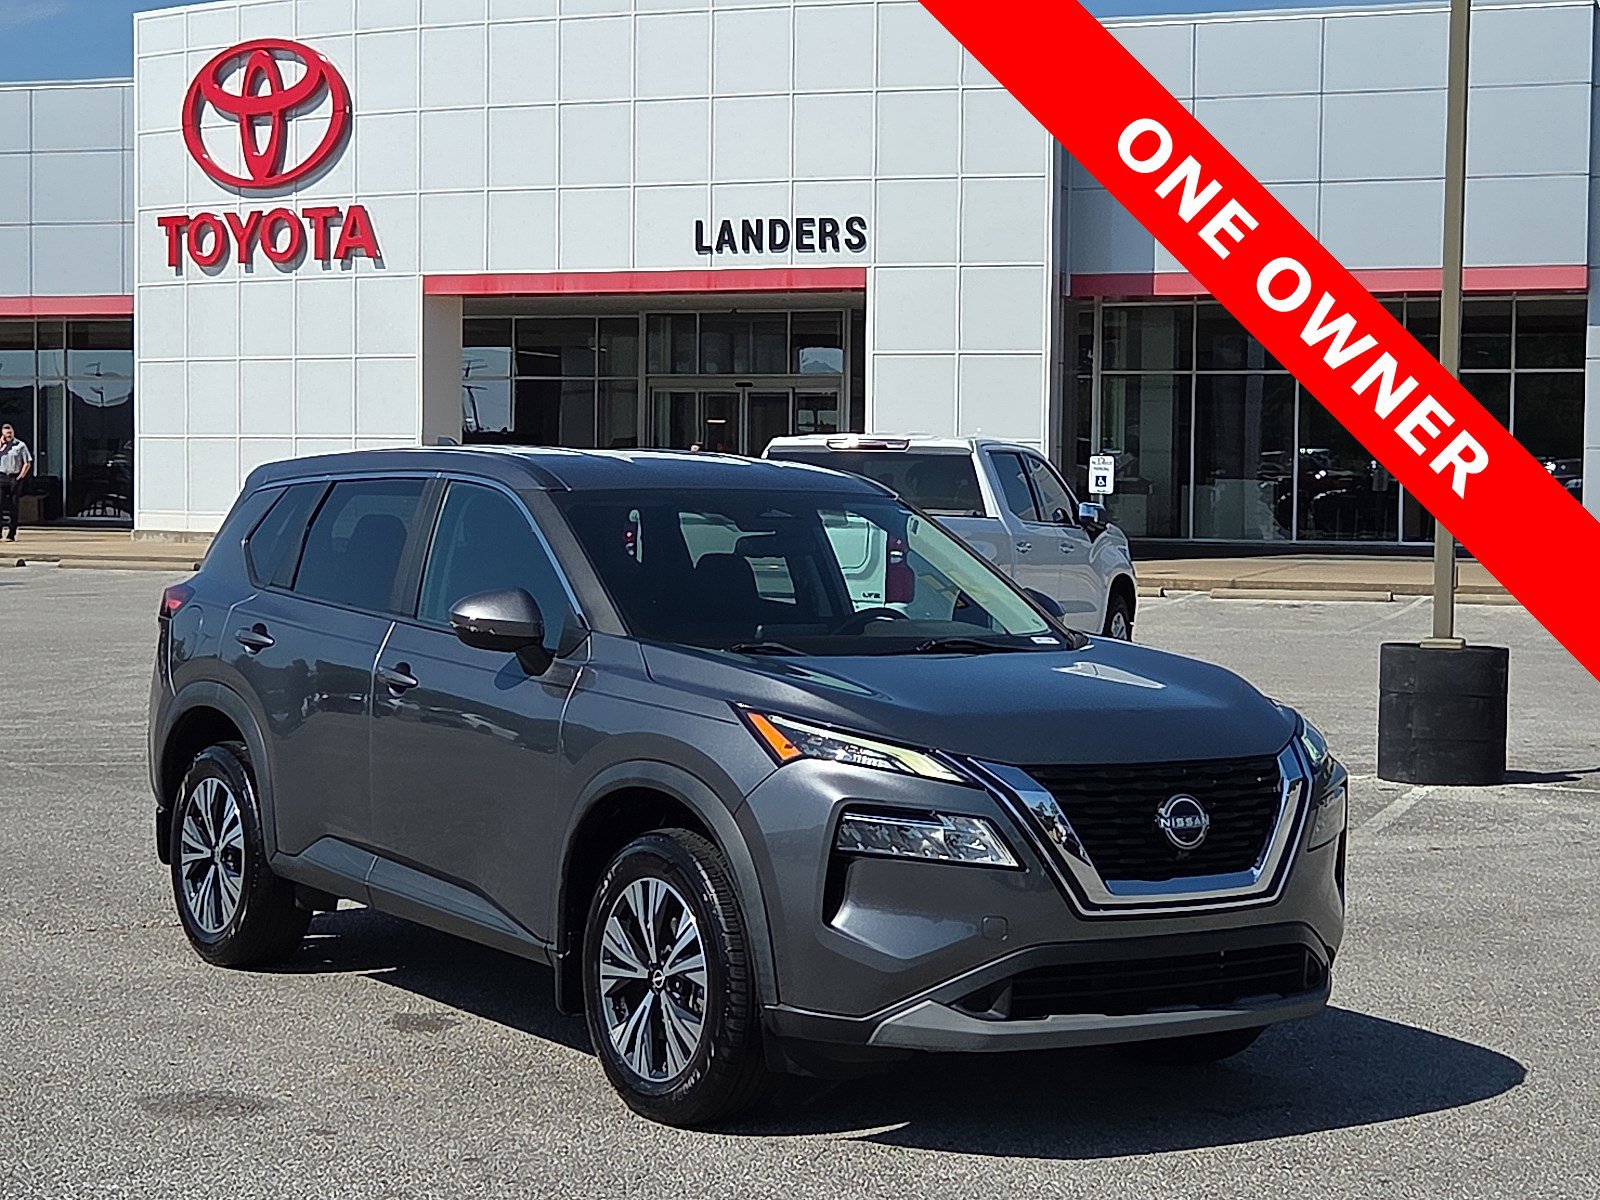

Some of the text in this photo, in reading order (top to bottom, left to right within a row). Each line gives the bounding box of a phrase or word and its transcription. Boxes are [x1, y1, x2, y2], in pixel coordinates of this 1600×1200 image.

[158, 205, 381, 268] TOYOTA
[695, 216, 867, 253] LANDERS
[1159, 813, 1209, 829] NISSAN
